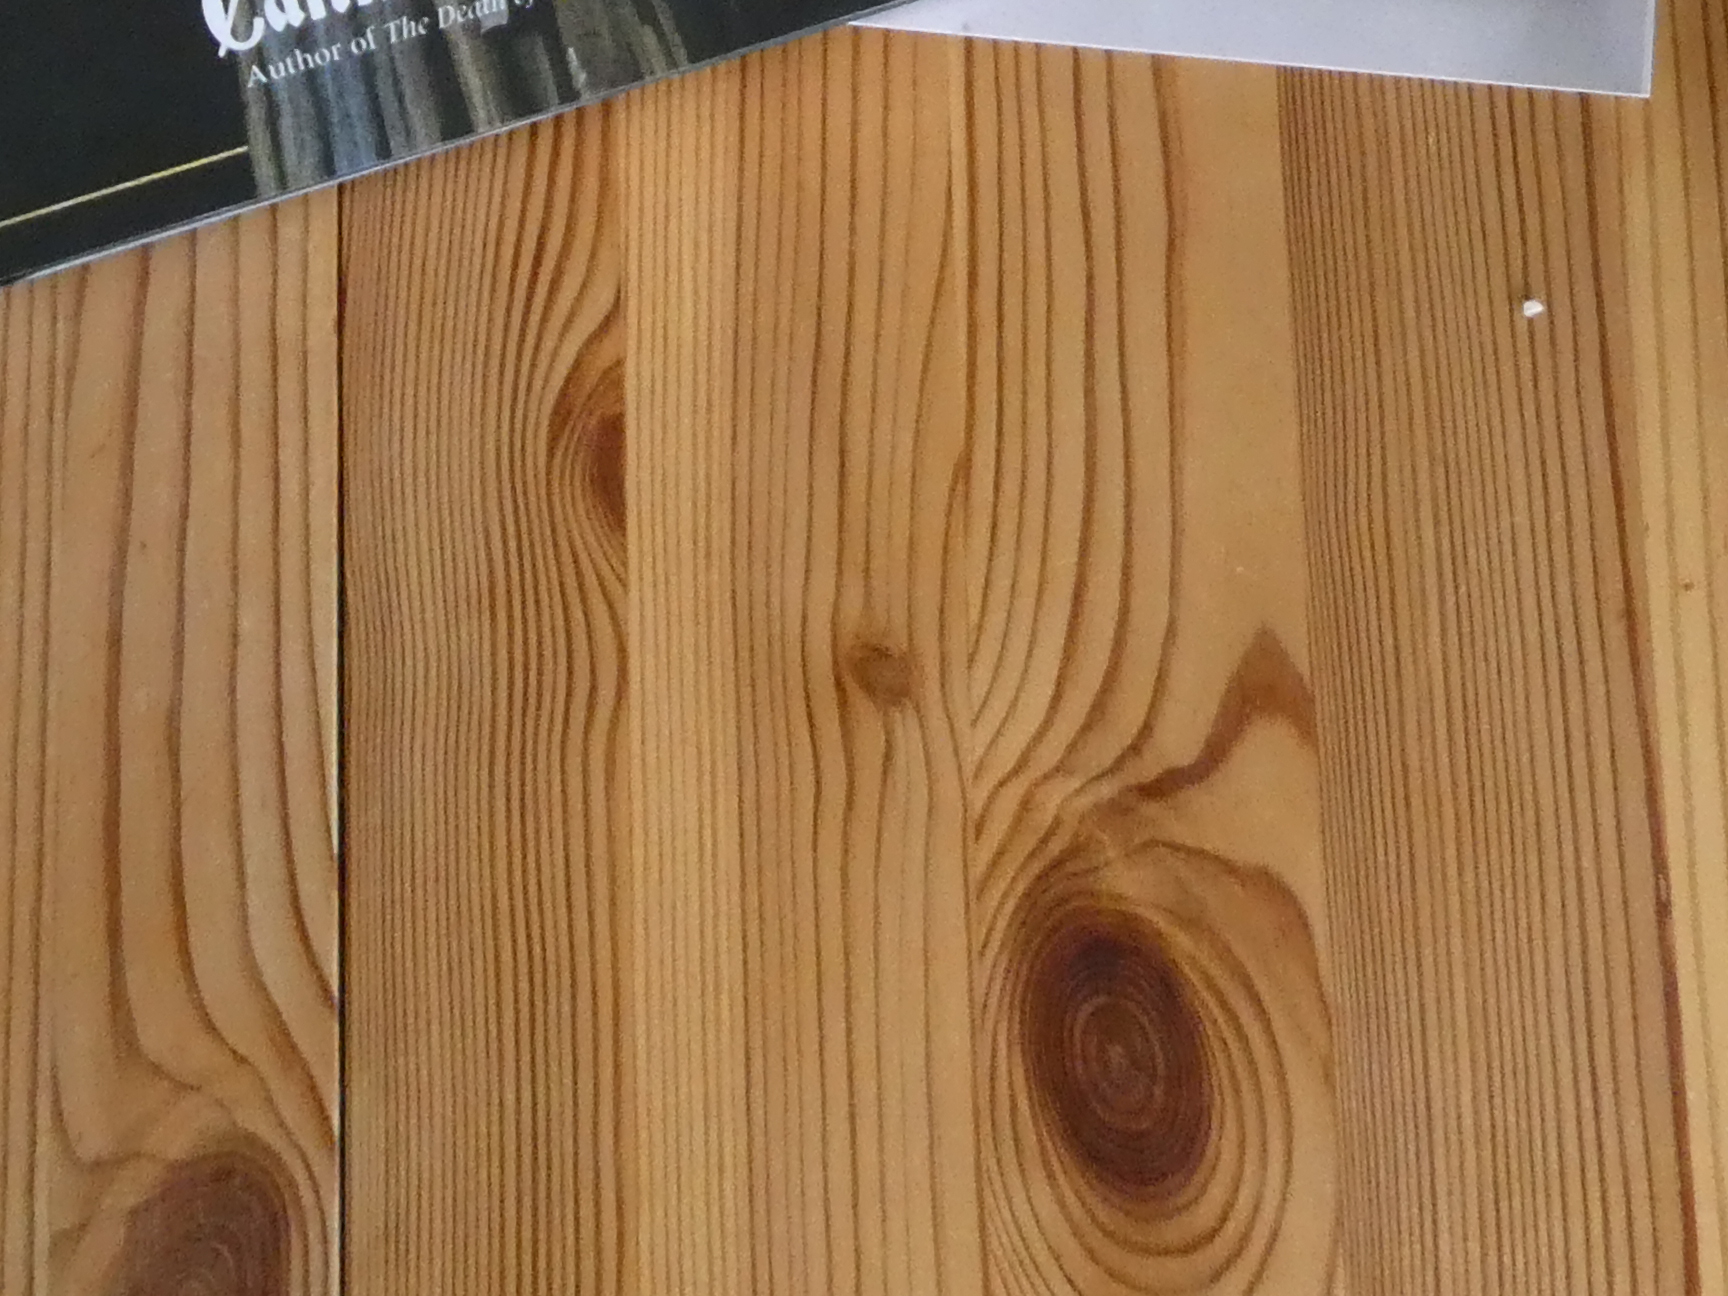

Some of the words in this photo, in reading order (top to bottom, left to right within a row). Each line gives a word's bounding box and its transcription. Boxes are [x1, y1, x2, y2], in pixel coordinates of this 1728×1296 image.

[247, 46, 343, 88] Author
[350, 30, 379, 57] of
[383, 14, 431, 47] The
